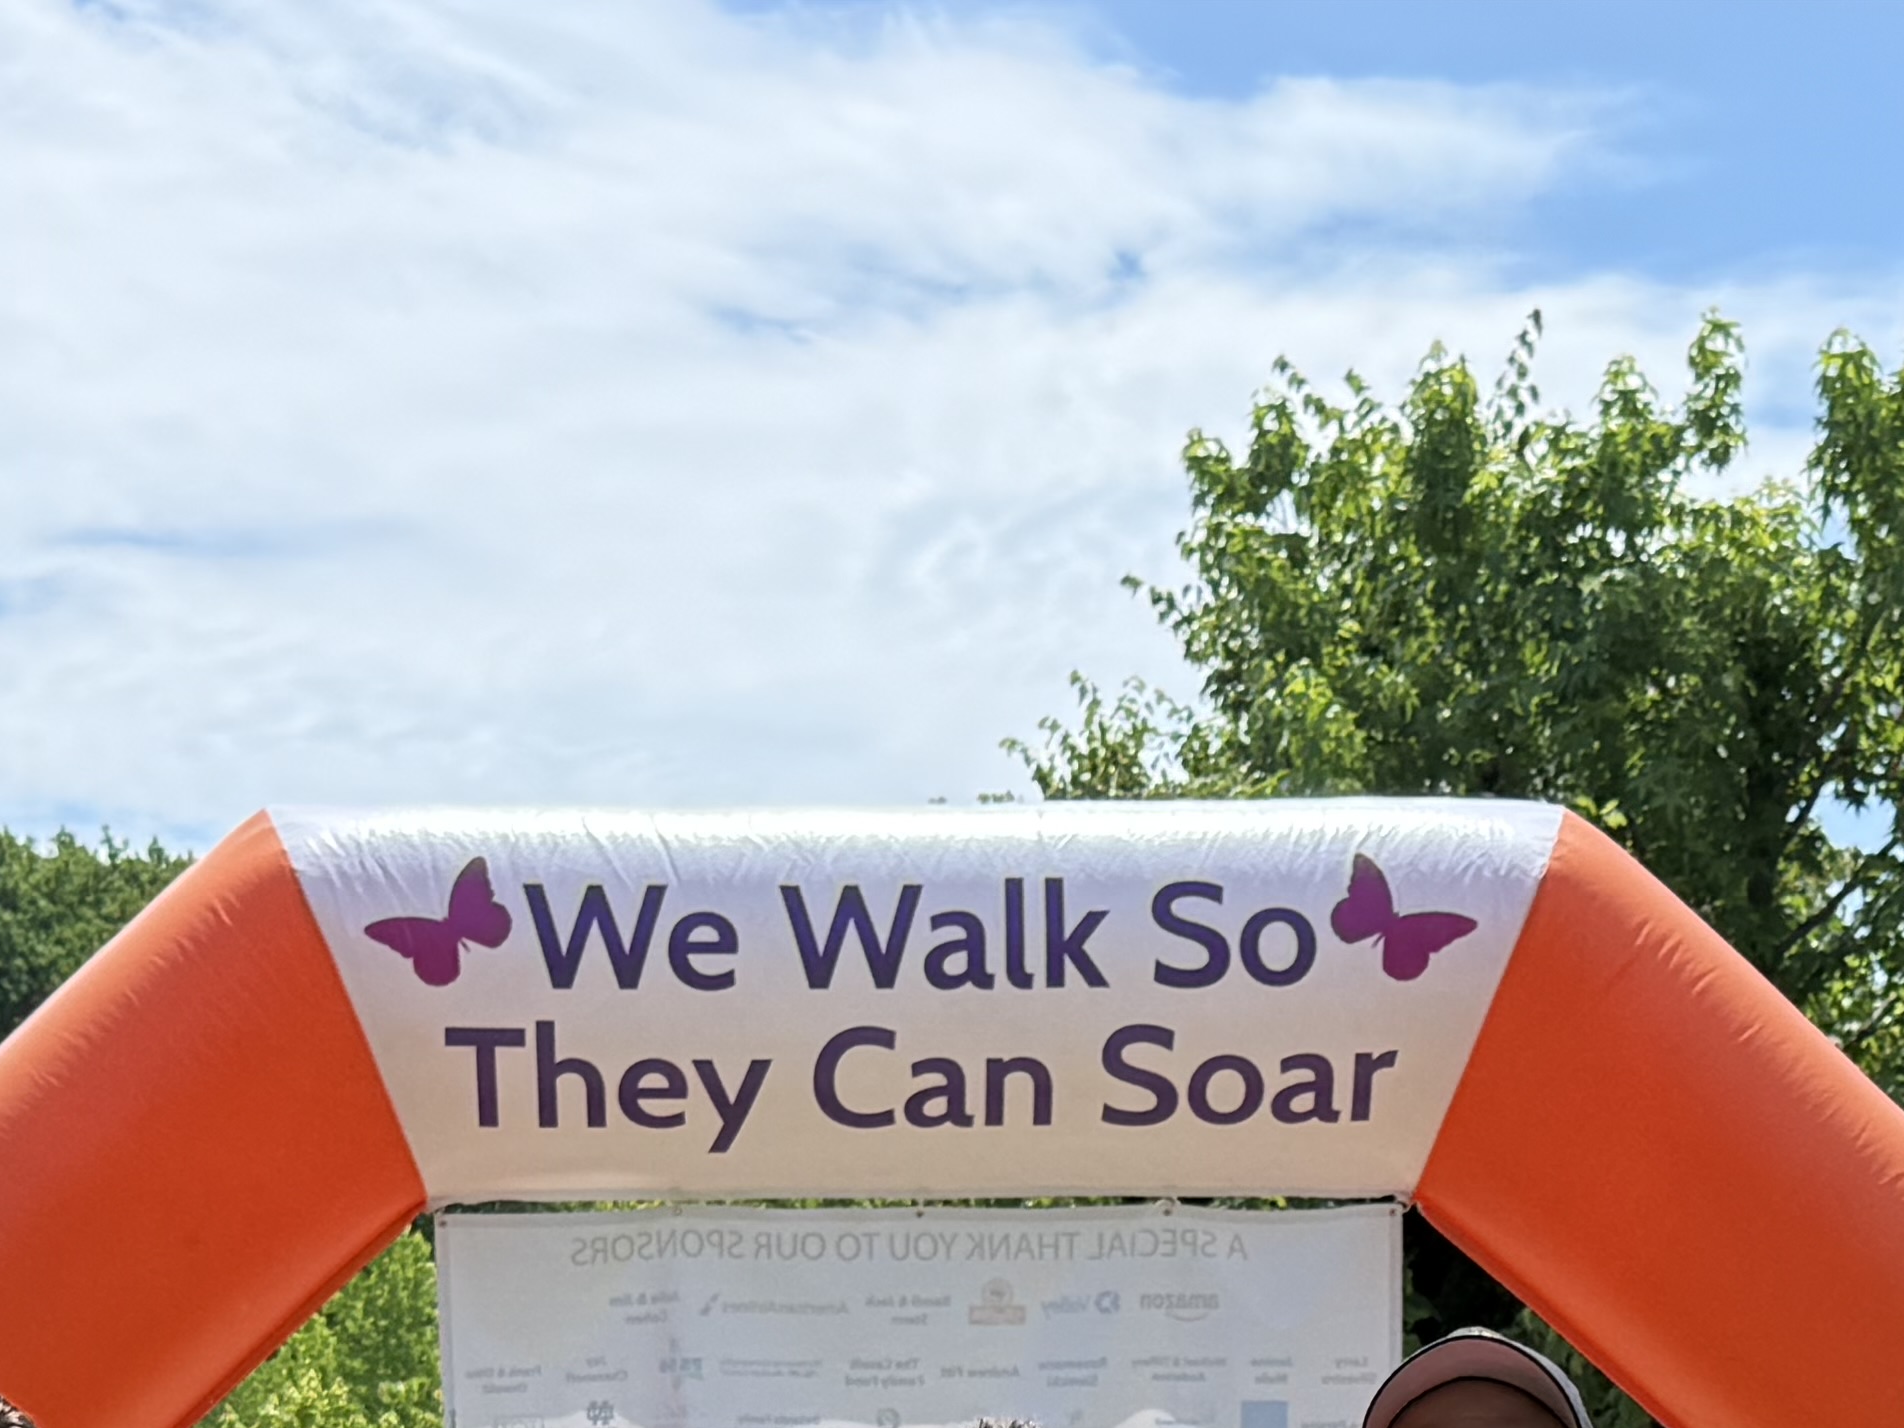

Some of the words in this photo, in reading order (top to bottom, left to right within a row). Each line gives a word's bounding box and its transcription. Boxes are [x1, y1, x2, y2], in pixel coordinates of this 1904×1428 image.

[524, 881, 740, 990] We
[780, 876, 1111, 990] Walk
[1151, 879, 1317, 990] So
[445, 1020, 772, 1154] They
[812, 1025, 1053, 1131] Can
[1100, 1023, 1398, 1126] Soar
